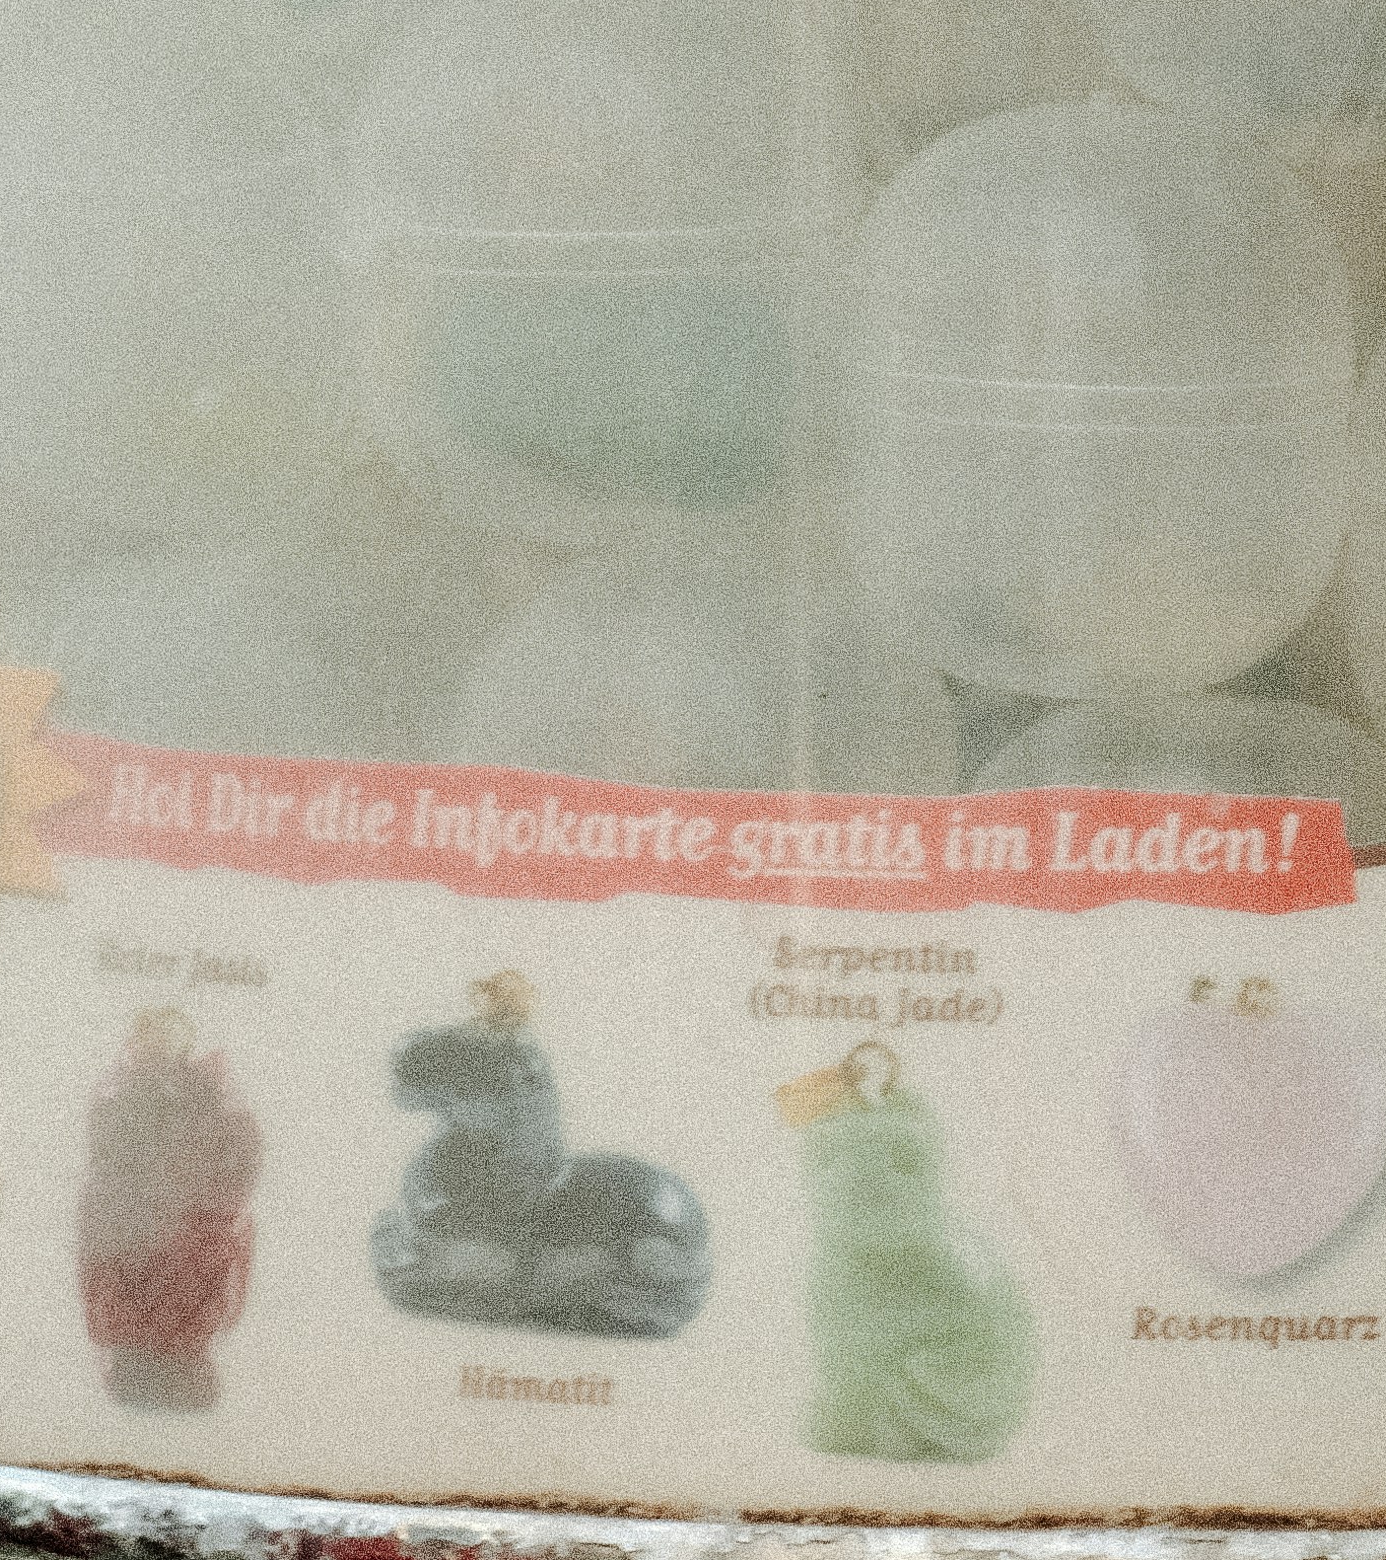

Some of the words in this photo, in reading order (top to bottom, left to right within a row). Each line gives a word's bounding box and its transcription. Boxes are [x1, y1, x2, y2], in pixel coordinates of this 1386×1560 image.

[215, 774, 299, 838] Dir
[305, 780, 396, 842] die
[414, 788, 716, 867] Infokarte
[728, 811, 925, 877] gratis
[944, 814, 1029, 870] im
[1047, 810, 1301, 874] Laden!
[771, 936, 976, 976] Serpentin
[1131, 1306, 1380, 1350] Rosenquarz
